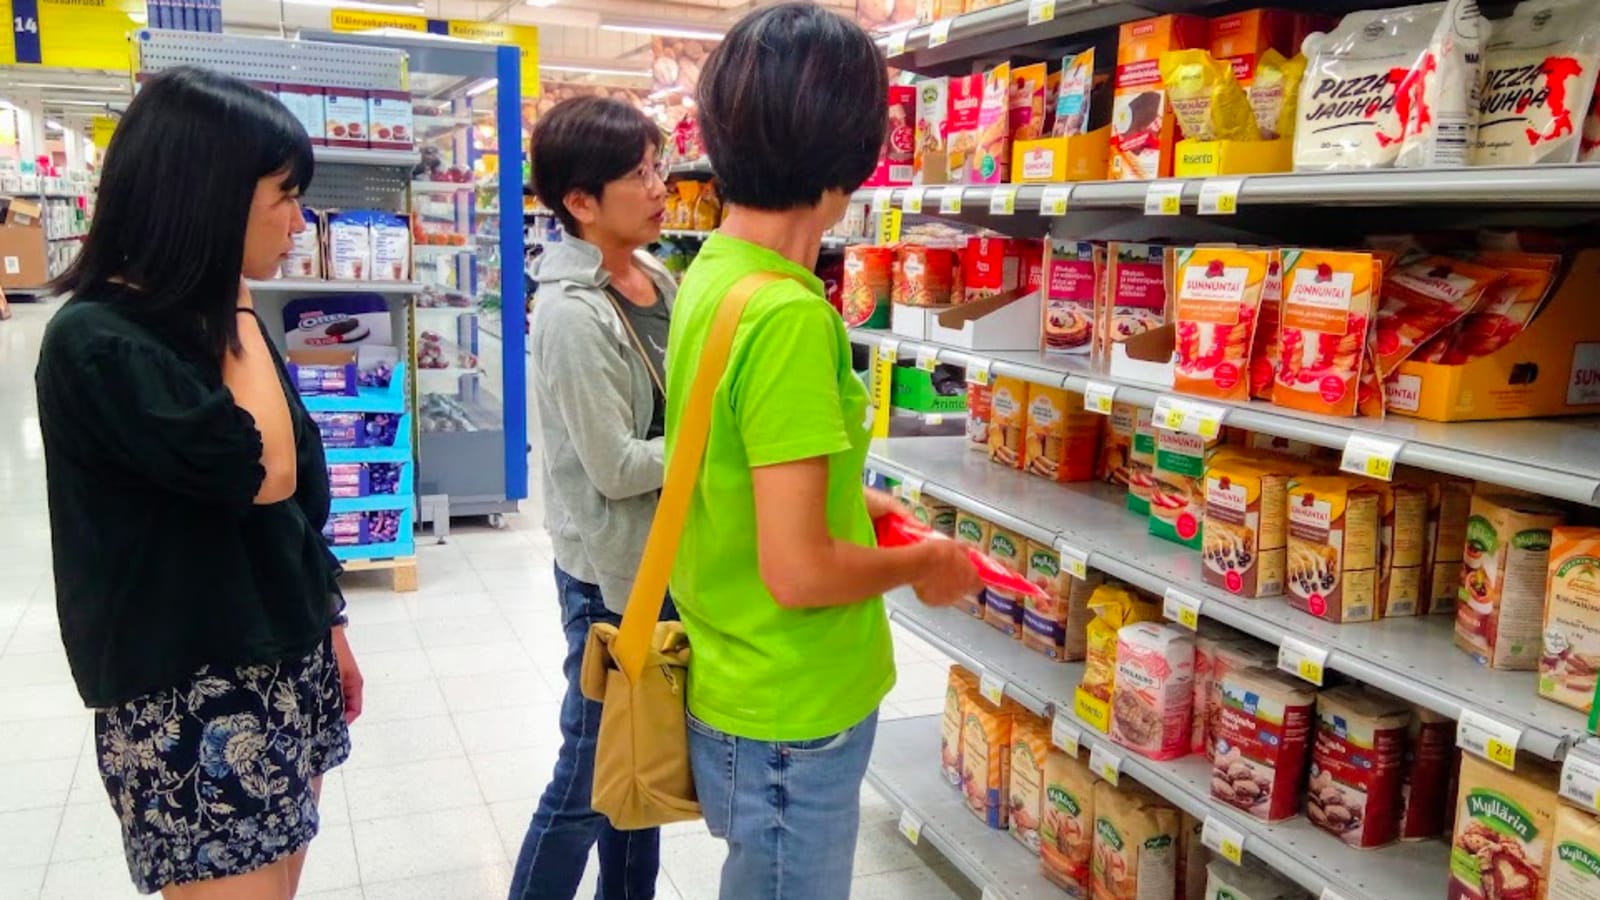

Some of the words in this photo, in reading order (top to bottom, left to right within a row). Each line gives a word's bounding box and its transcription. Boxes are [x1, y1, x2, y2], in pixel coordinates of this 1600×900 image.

[14, 16, 37, 34] 14
[1312, 73, 1391, 100] PIZZA
[1306, 95, 1397, 121] JAUHOA
[1187, 280, 1240, 293] SUNNUNTAI
[1294, 284, 1345, 299] SUNNUNTAI
[1575, 369, 1600, 386] SUN
[1385, 384, 1416, 401] UNTAI
[1471, 797, 1528, 837] Myllärin
